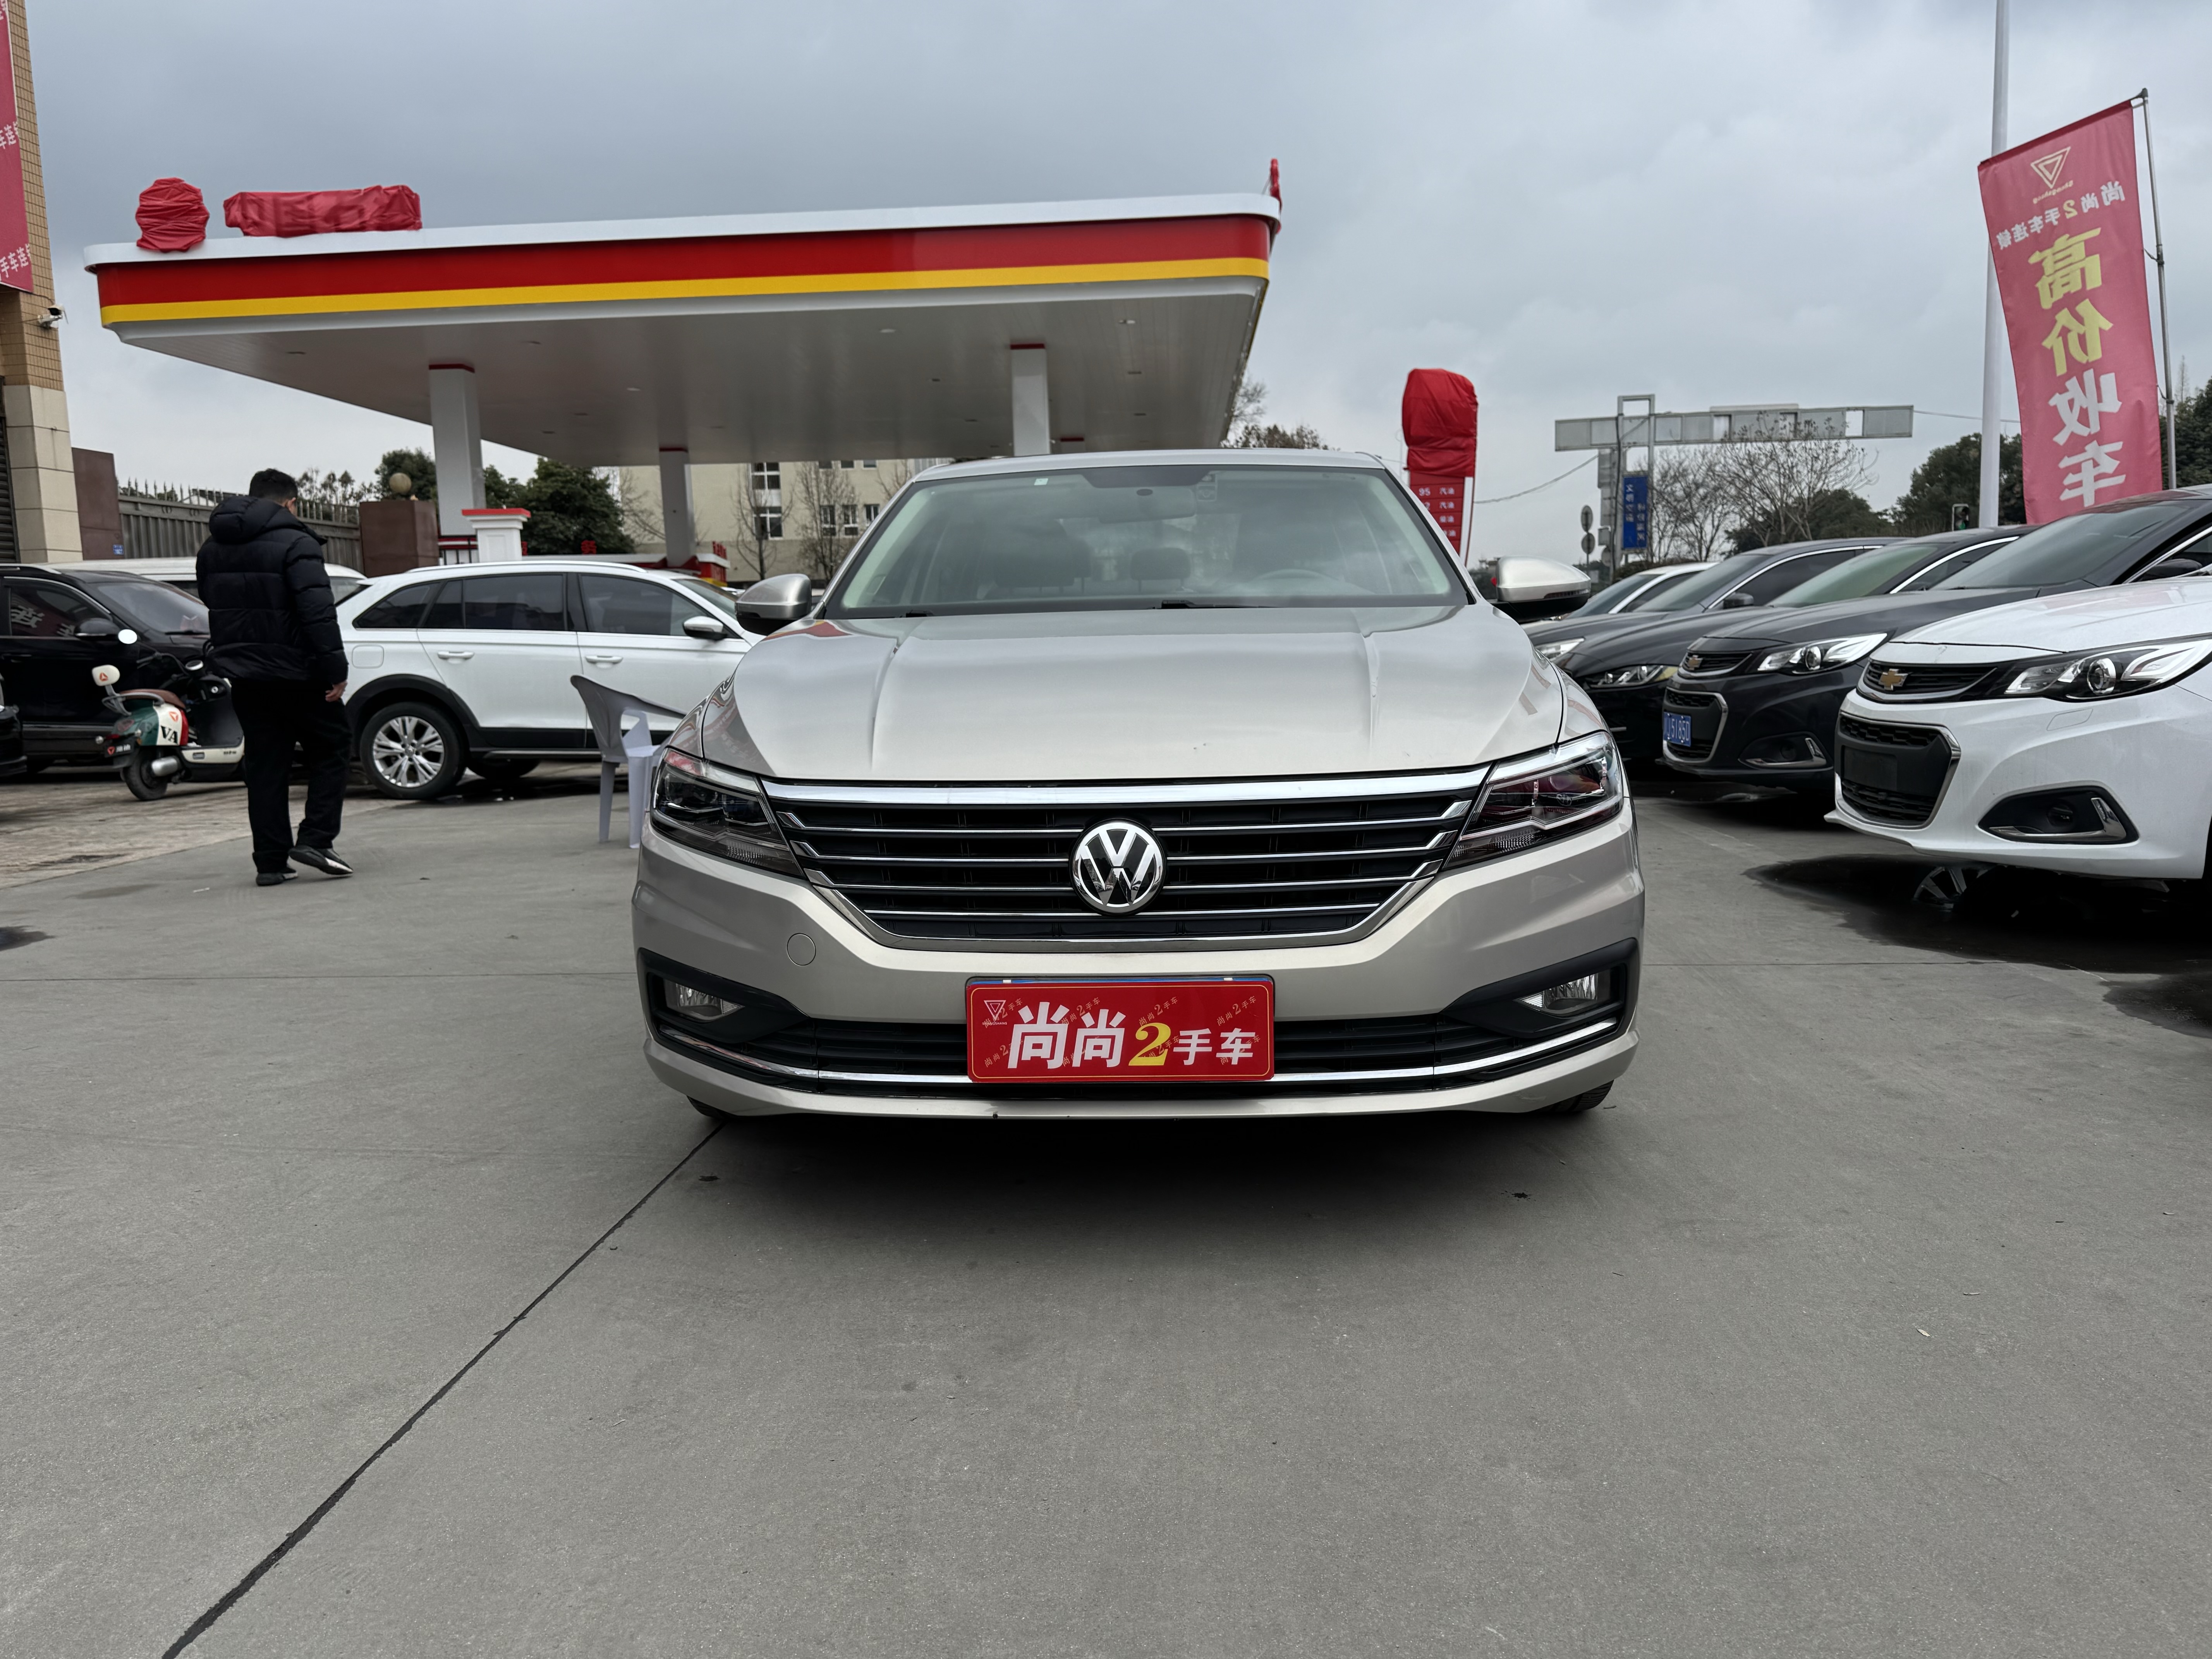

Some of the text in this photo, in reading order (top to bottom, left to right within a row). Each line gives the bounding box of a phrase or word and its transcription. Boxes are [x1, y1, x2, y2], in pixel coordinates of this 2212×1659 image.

[0, 244, 30, 281] 手车连
[1419, 487, 1431, 496] 95
[161, 725, 178, 745] VA
[1077, 825, 1159, 909] VW
[1139, 996, 1178, 1026] 尚尚2手车
[1217, 996, 1256, 1026] 尚尚2手车
[1008, 1001, 1255, 1069] 尚尚2手车
